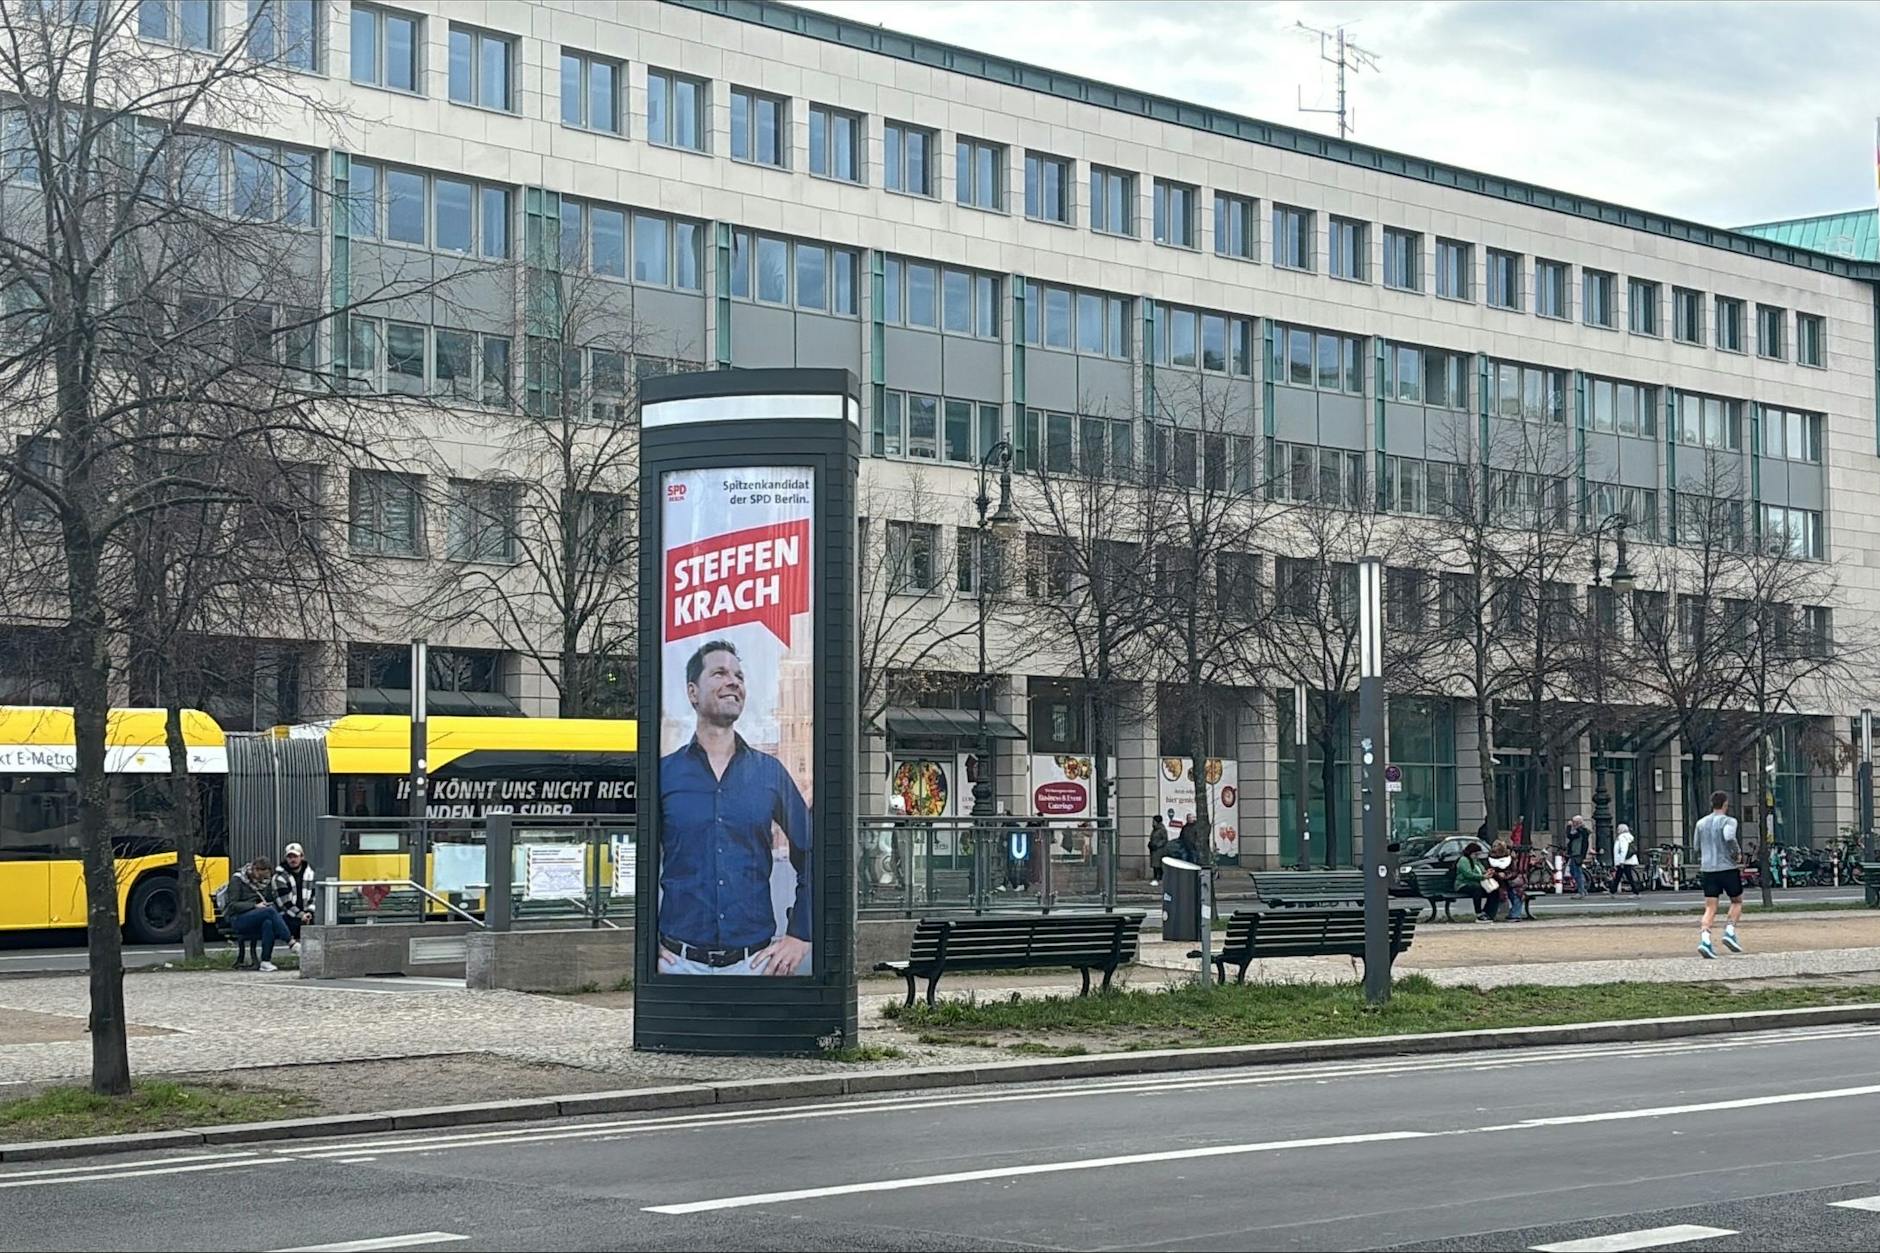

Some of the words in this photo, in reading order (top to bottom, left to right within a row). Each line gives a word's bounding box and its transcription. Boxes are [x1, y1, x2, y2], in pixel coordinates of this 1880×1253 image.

[667, 484, 687, 496] SPD
[723, 480, 809, 492] Spitzenkandidat
[730, 495, 746, 504] der
[750, 494, 771, 504] SPD
[774, 493, 809, 504] Berlin.
[674, 535, 799, 592] STEFFEN
[674, 574, 779, 627] KRACH
[17, 751, 74, 766] E-Metro
[433, 778, 497, 800] KÖNNT
[501, 781, 537, 800] UNS
[541, 781, 593, 799] NICHT
[597, 781, 637, 799] RIEC
[1011, 833, 1027, 859] U
